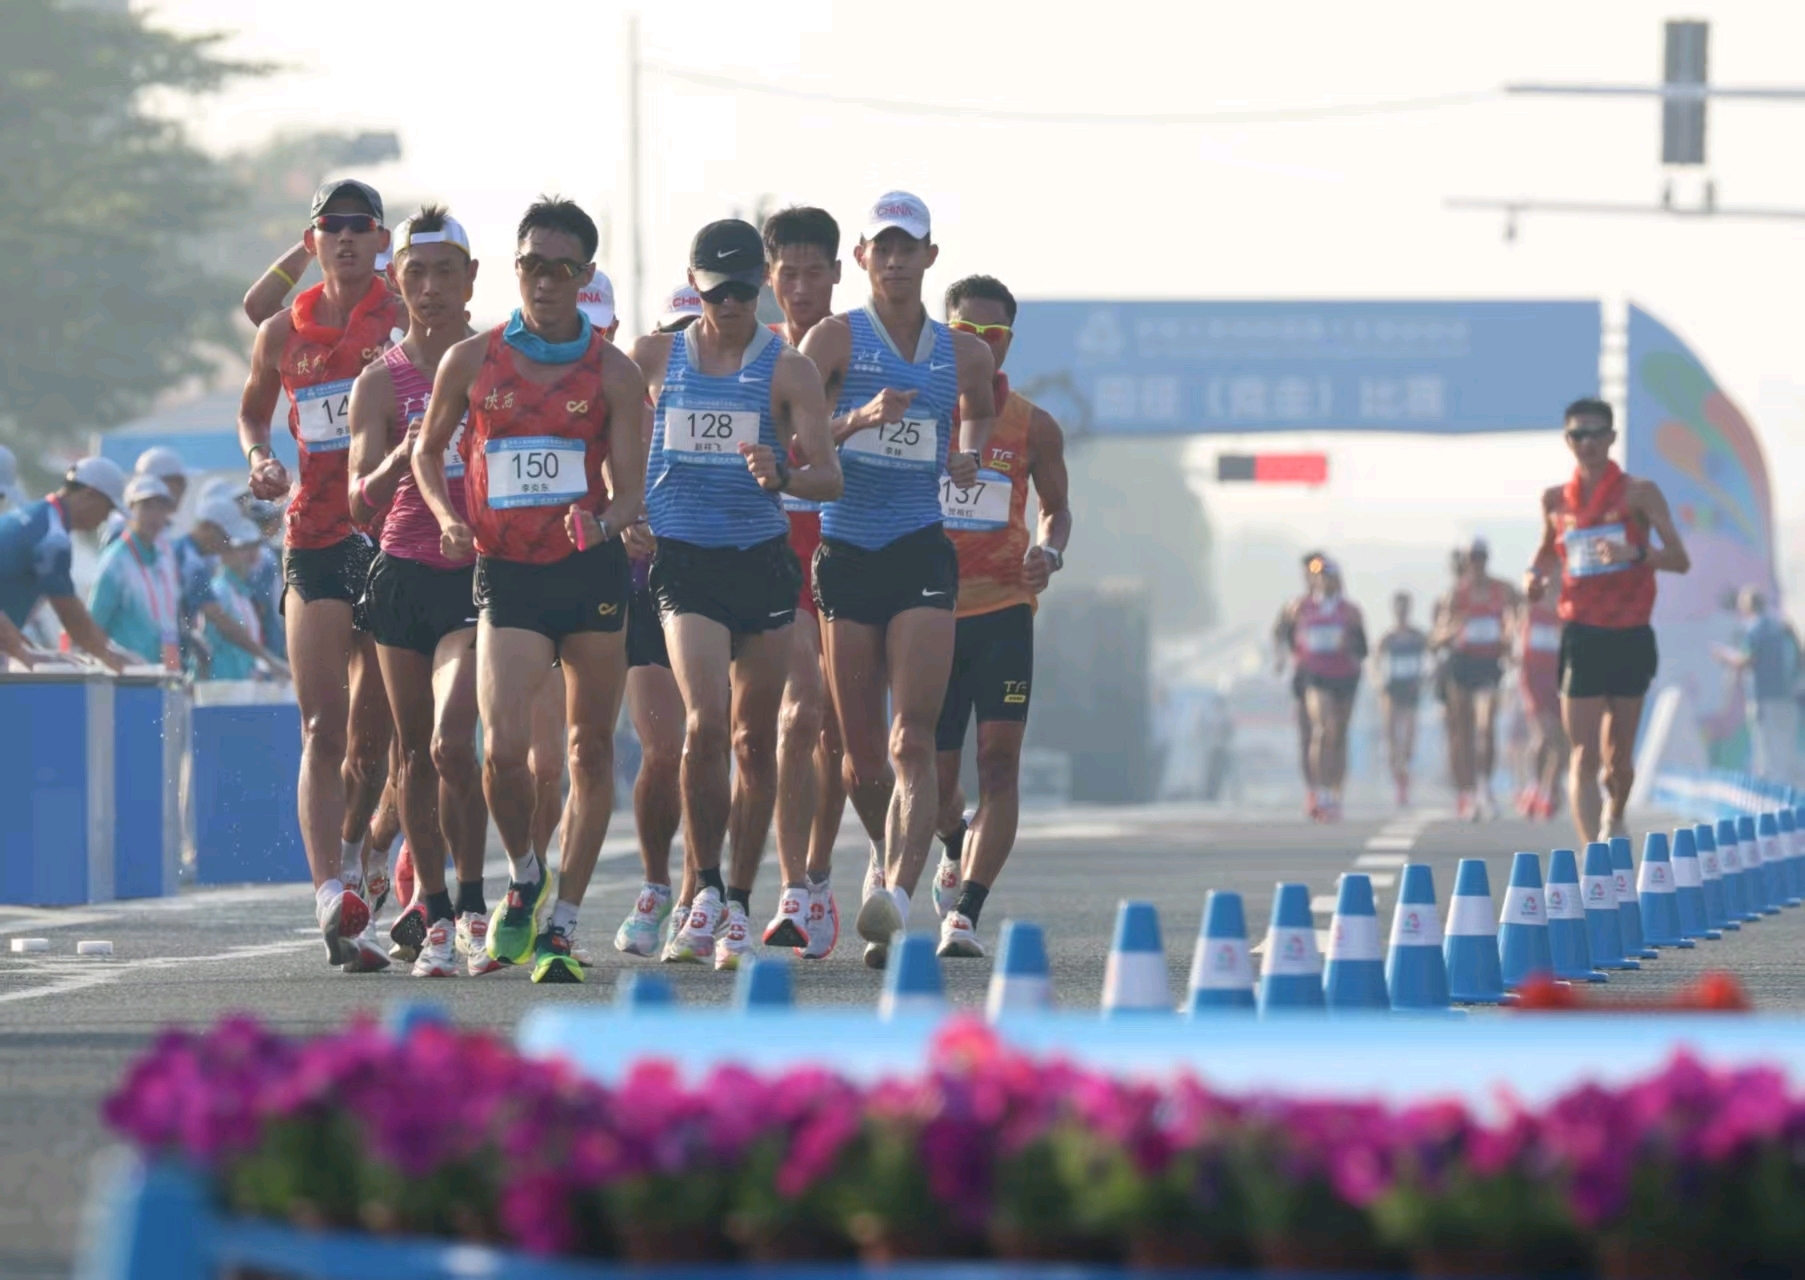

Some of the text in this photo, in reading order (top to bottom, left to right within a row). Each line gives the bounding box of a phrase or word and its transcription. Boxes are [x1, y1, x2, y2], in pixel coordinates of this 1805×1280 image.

[877, 205, 914, 217] CHINA
[687, 413, 733, 439] 128
[879, 420, 921, 446] 125
[512, 452, 559, 479] 150
[942, 480, 986, 505] 137
